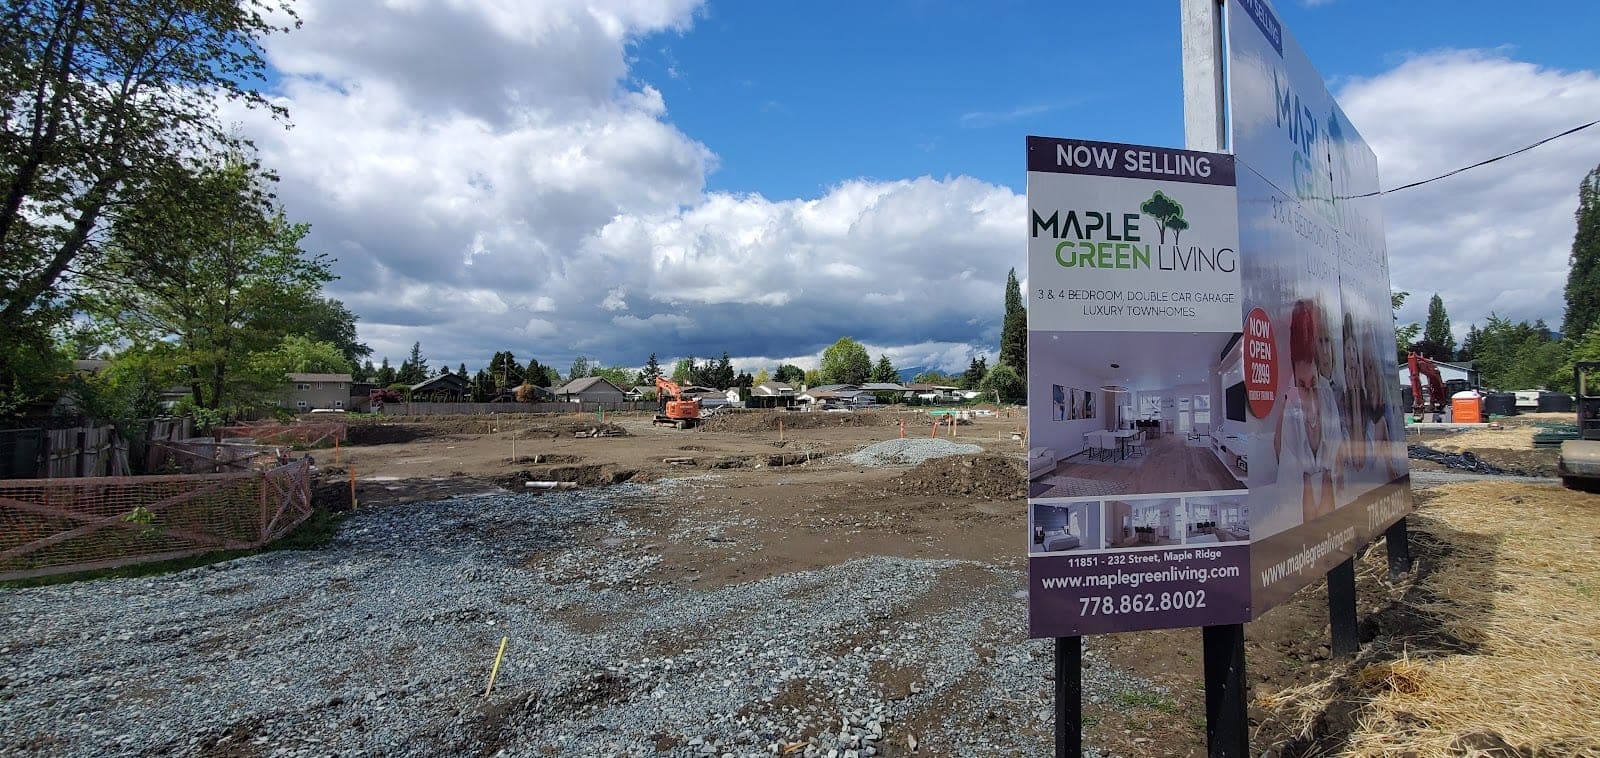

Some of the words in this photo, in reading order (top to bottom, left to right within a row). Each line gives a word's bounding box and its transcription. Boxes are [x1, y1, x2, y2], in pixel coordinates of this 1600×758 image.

[1056, 143, 1118, 170] NOW
[1123, 151, 1212, 178] SELLING
[1032, 208, 1141, 242] MAPLE
[1055, 240, 1151, 270] GREEN
[1158, 244, 1236, 273] LIVING
[1038, 289, 1044, 300] 3
[1047, 289, 1054, 300] &
[1058, 289, 1065, 299] 4
[1127, 291, 1169, 302] DOUBLE
[1171, 292, 1192, 303] CAR
[1194, 293, 1235, 304] GARAGE
[1083, 305, 1124, 316] LUXURY
[1127, 306, 1196, 317] TOWNHOMES
[1249, 318, 1270, 339] NOW
[1249, 340, 1272, 360] OPEN
[1068, 557, 1098, 568] 11851
[1108, 555, 1126, 566] 232
[1128, 554, 1161, 564] Street,
[1163, 551, 1193, 562] Maple
[1195, 549, 1222, 561] Ridge
[1261, 525, 1355, 588] www.maplegreenliving.com
[1042, 565, 1240, 590] www.maplegreenliving.com
[1079, 589, 1206, 617] 778.862.8002
